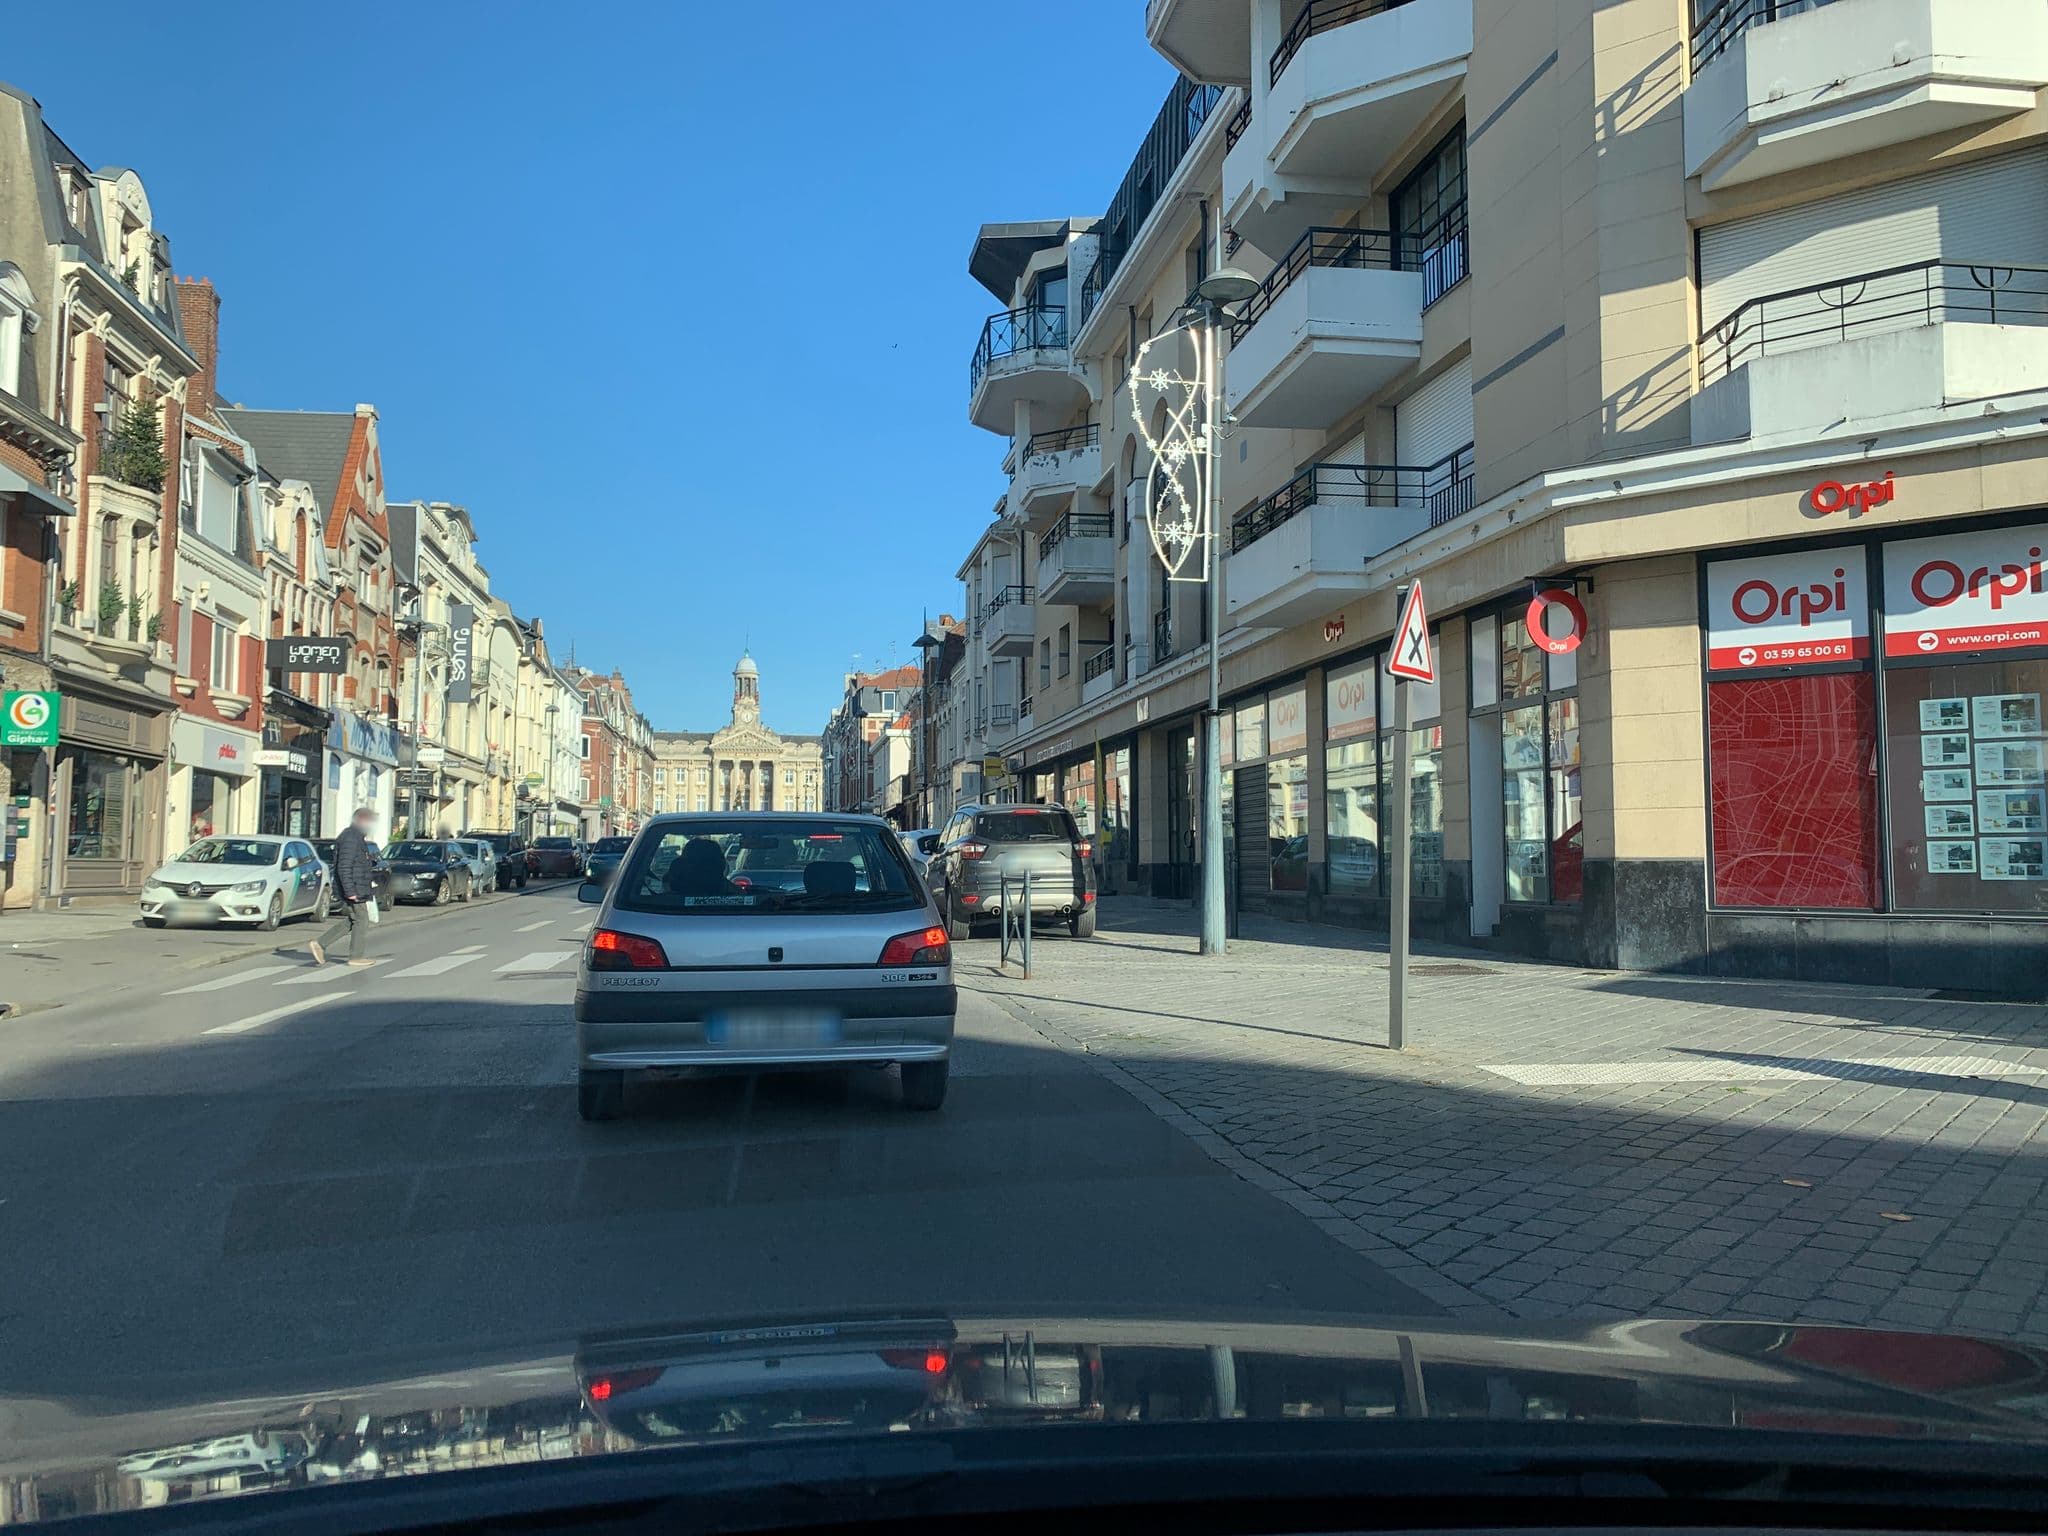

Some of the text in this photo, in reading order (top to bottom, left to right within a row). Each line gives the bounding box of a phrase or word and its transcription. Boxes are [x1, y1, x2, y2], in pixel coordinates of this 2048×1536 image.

[1811, 470, 1894, 512] Orpi
[1911, 546, 2042, 610] Orpi
[1732, 568, 1845, 626] Orpi
[1324, 612, 1345, 643] Orpi
[1947, 630, 2041, 645] www.orpi.com
[289, 645, 340, 657] WOMEN
[1548, 641, 1568, 653] Orpi
[1763, 644, 1846, 660] 03 59 65 00 61
[1338, 674, 1366, 712] Orpi
[1277, 693, 1299, 728] Orpi
[7, 734, 49, 745] Giphar
[602, 977, 661, 987] PEUGEOT
[881, 973, 906, 983] 306
